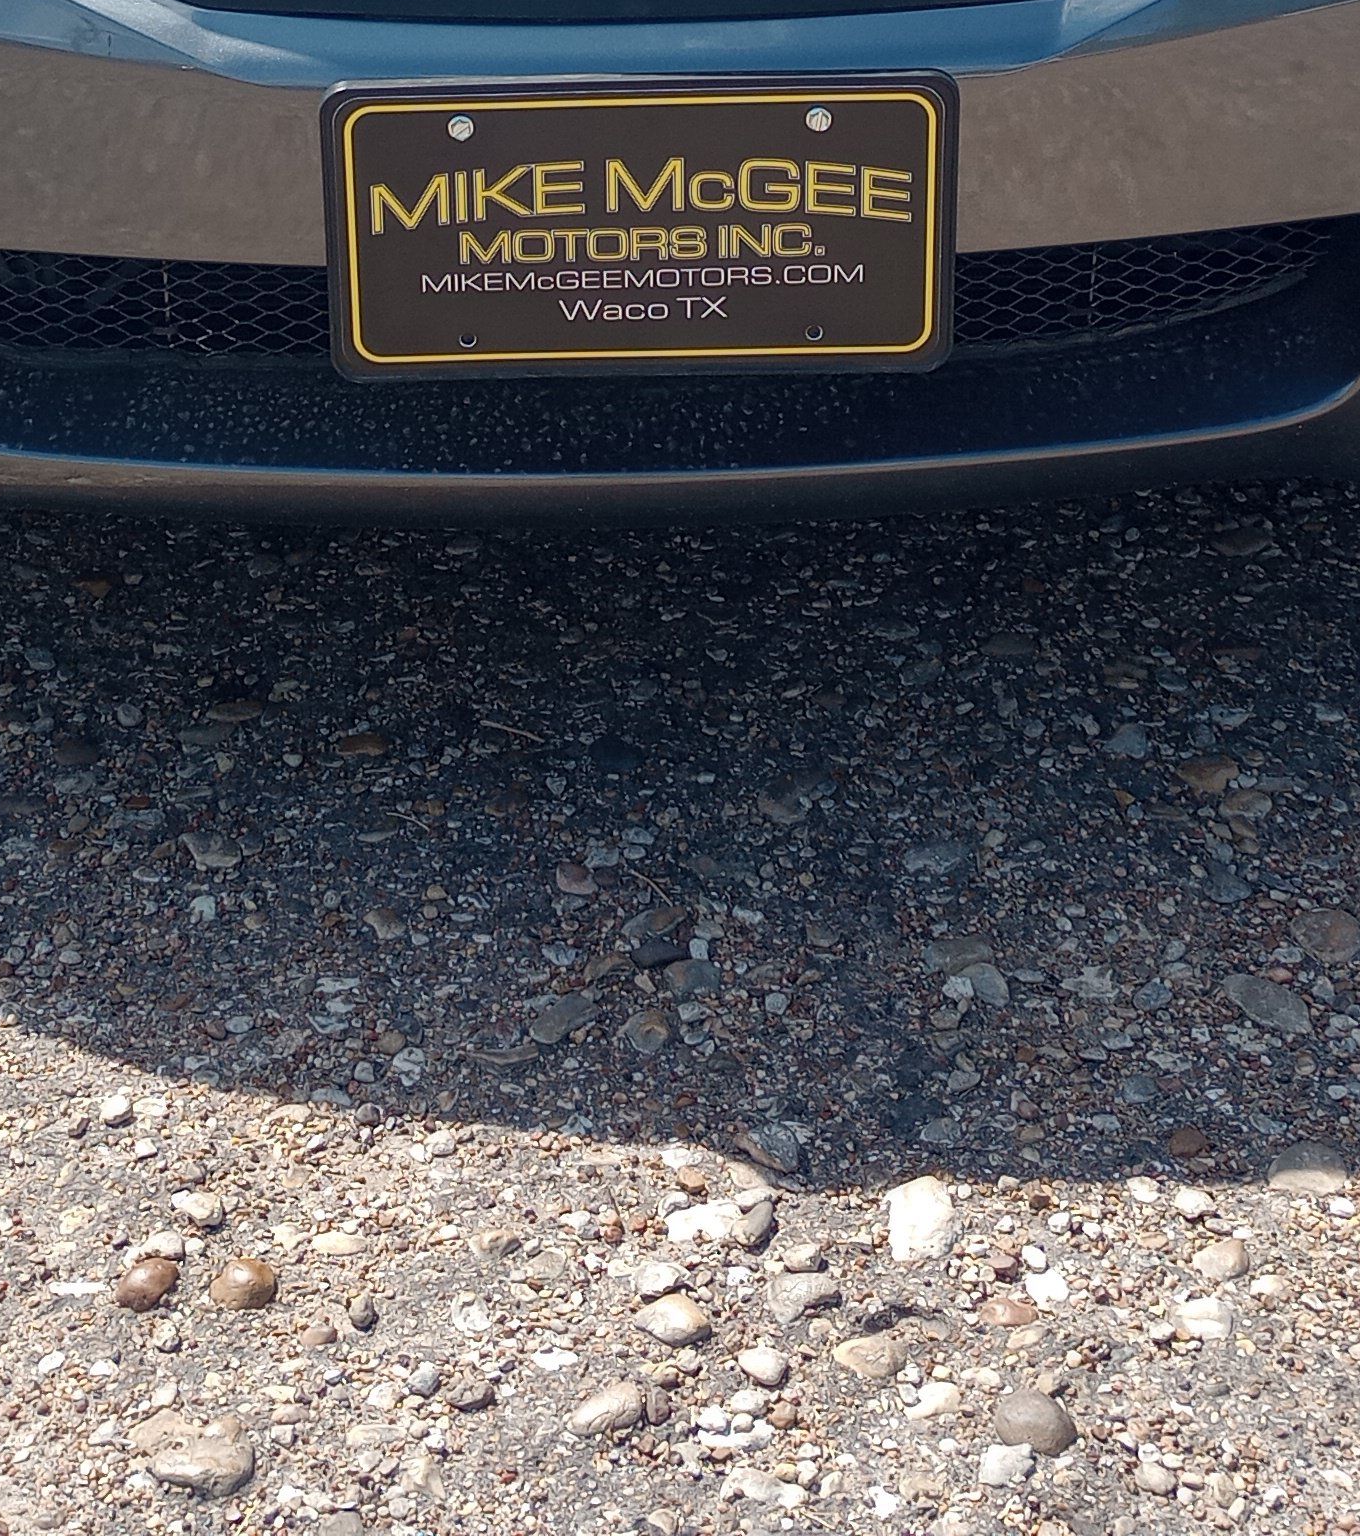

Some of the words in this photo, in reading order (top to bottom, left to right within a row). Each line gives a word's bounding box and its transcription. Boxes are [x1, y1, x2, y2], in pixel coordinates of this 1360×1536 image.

[370, 160, 586, 236] MIKE
[605, 156, 912, 223] McGEE
[459, 223, 708, 265] MOTORS
[718, 222, 826, 260] INC.
[558, 298, 670, 322] Waco
[676, 295, 729, 320] TX
